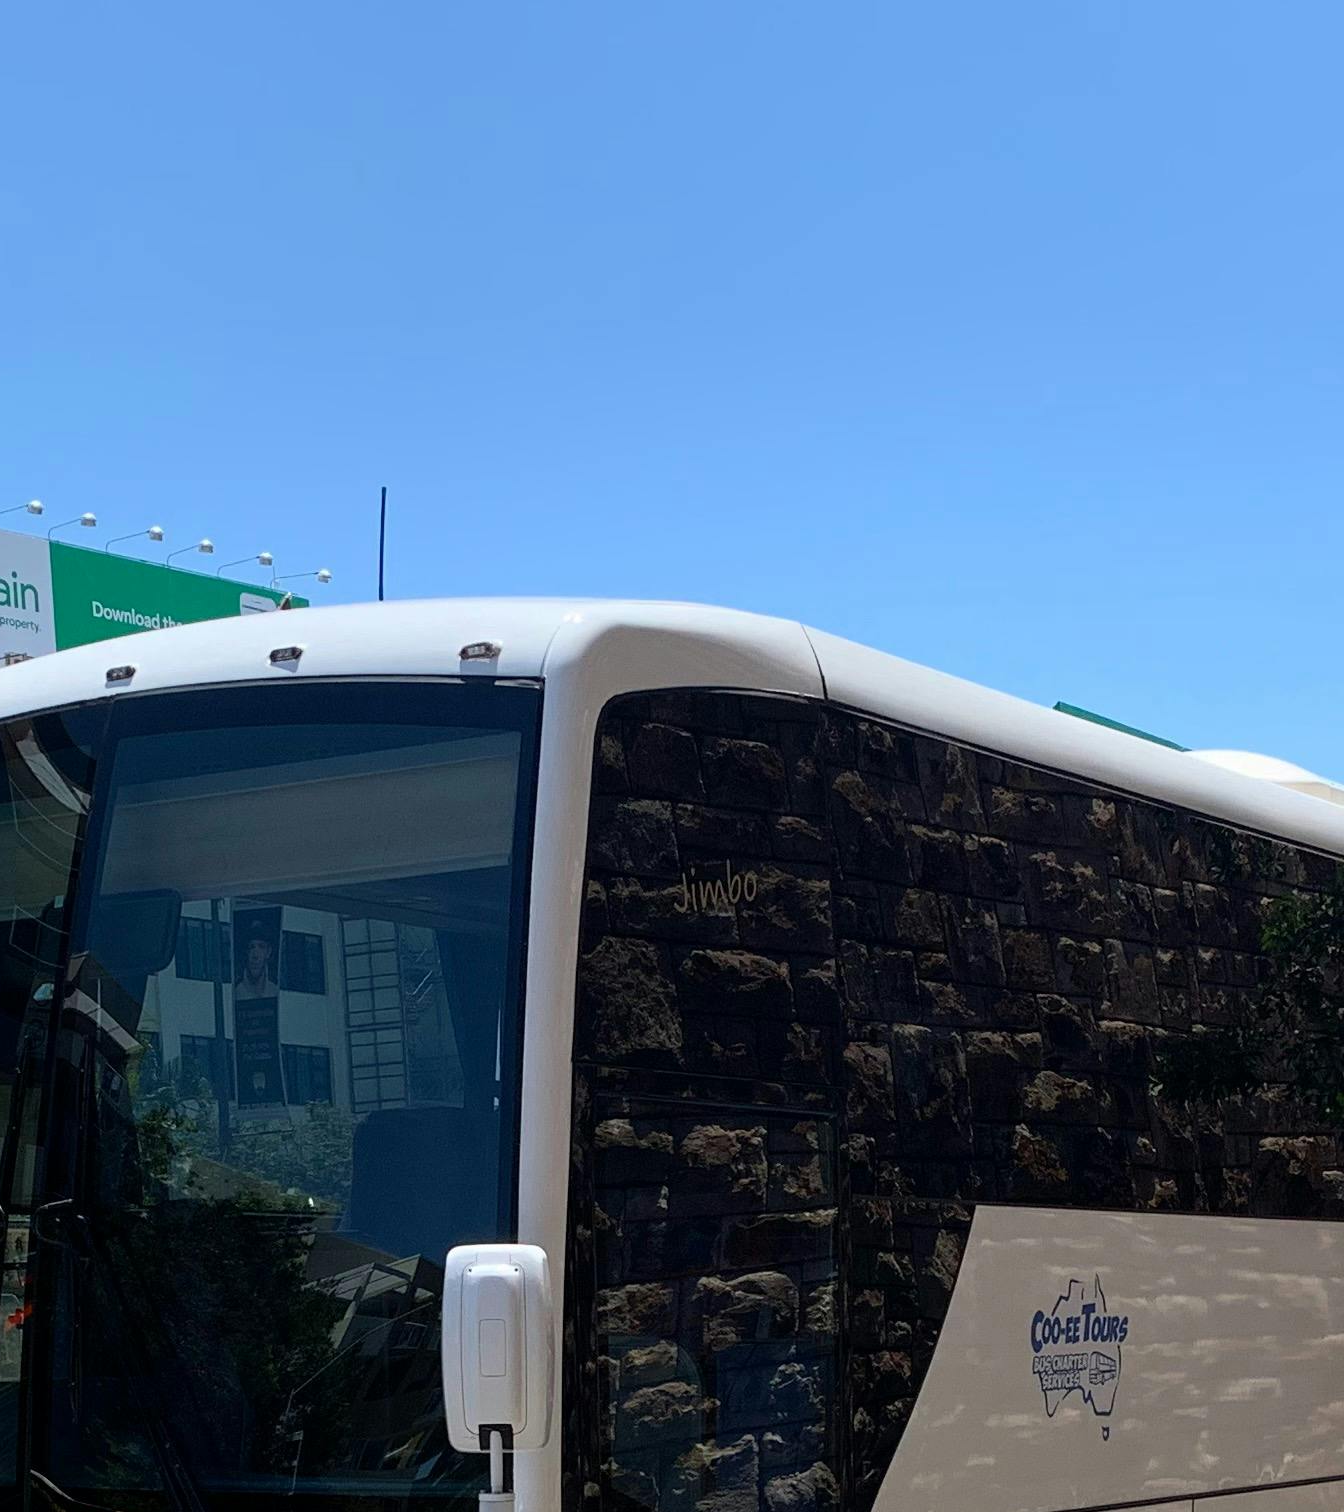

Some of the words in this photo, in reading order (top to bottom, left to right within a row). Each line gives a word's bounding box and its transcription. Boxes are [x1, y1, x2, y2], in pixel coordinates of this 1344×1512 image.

[0, 614, 42, 634] property.
[92, 600, 161, 630] Download
[1033, 1355, 1053, 1374] BUS
[1053, 1353, 1089, 1372] CHARTER
[1041, 1372, 1081, 1391] SERVICES
